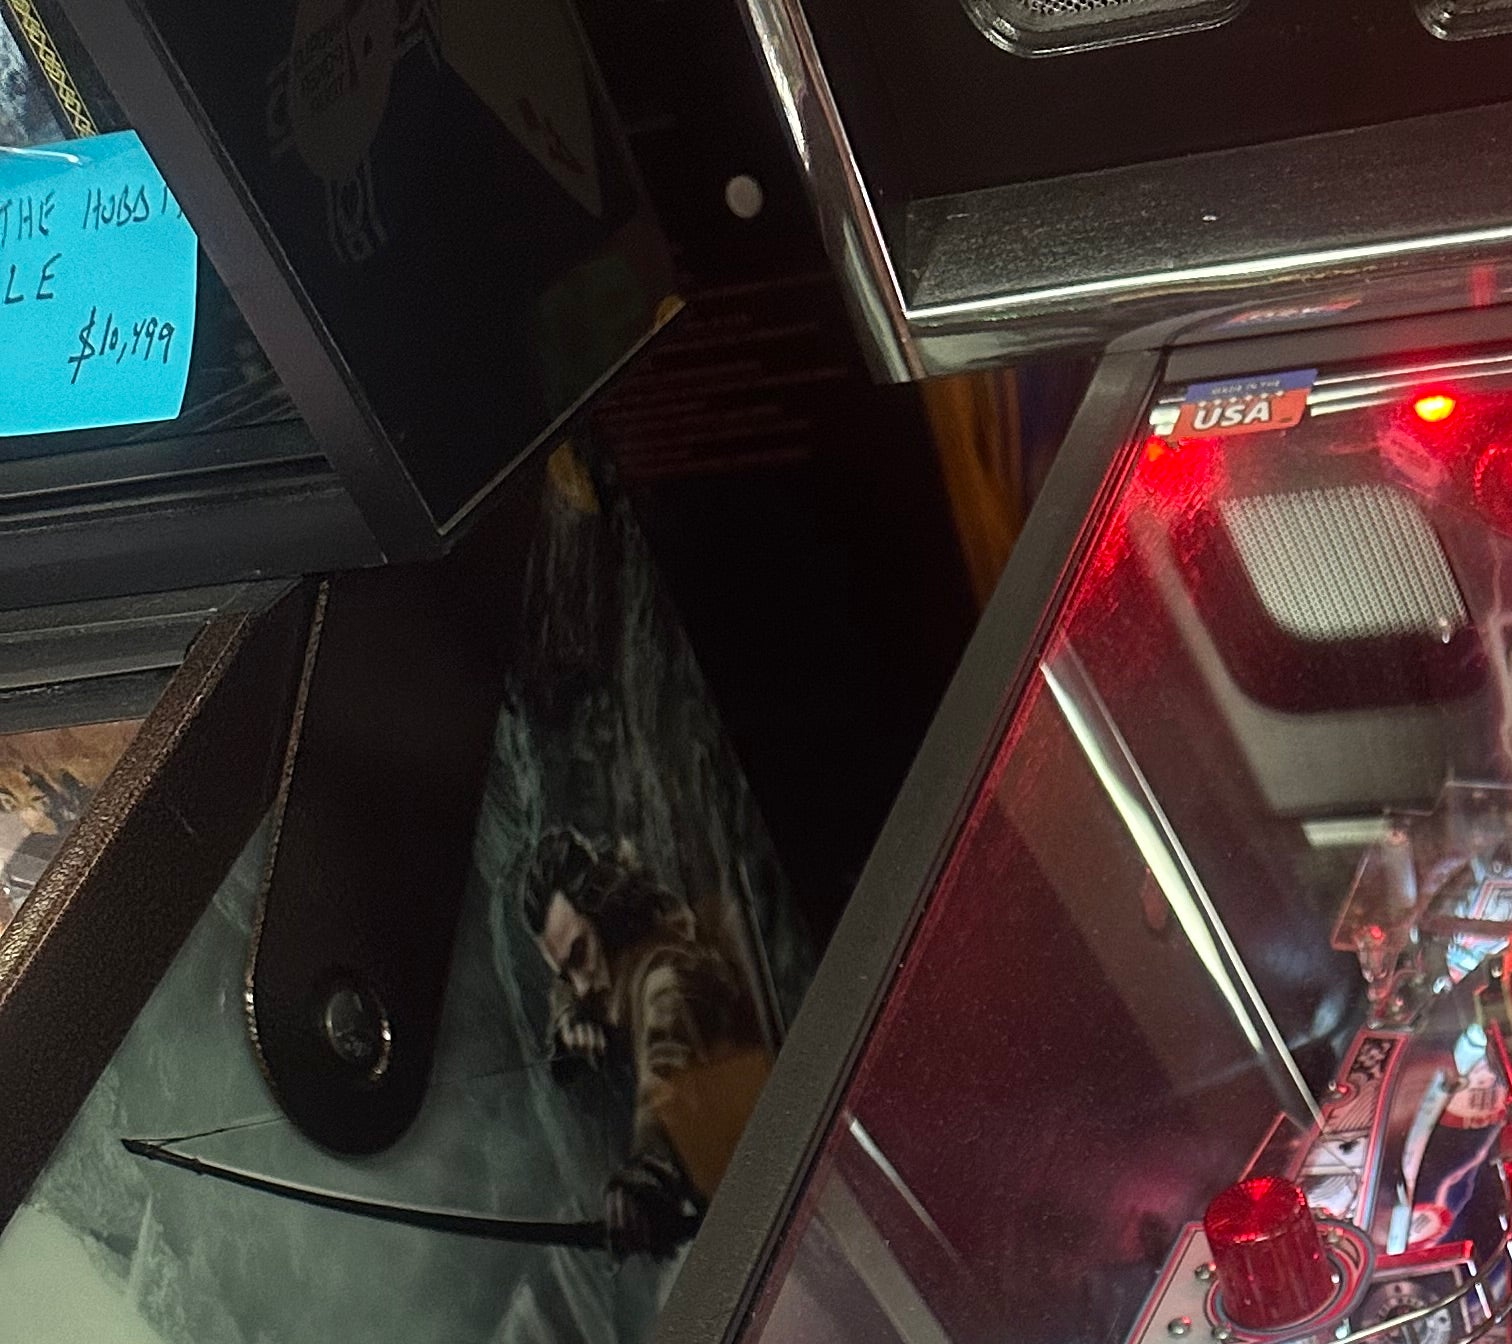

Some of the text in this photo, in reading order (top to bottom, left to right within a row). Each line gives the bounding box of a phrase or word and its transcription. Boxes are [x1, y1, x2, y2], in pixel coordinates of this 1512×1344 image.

[0, 191, 55, 248] THE
[68, 306, 175, 384] $10,499
[1193, 401, 1271, 431] USA
